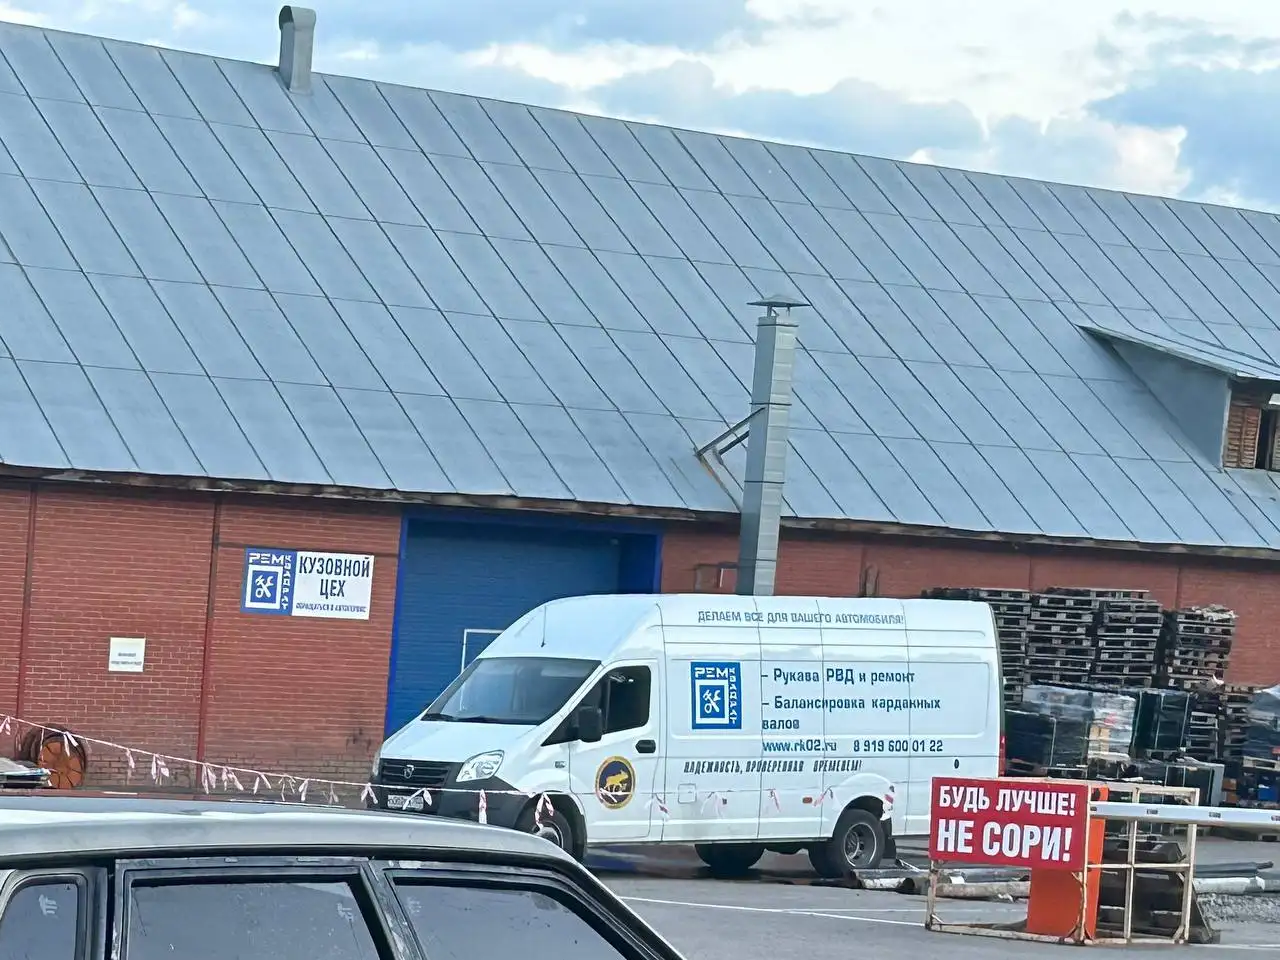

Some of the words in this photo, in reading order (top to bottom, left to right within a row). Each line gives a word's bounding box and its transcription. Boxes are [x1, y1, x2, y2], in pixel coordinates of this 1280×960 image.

[249, 553, 285, 564] РЕМ
[298, 556, 370, 577] КУЗОВНОЙ
[319, 579, 346, 599] ЦЕХ
[698, 611, 741, 623] ДЕЛАЕМ
[745, 612, 763, 622] ВСЕ
[767, 612, 788, 624] ДЛЯ
[791, 612, 831, 623] ВАШЕГО
[695, 667, 729, 678] РЕМ
[773, 668, 820, 685] Рукава
[826, 668, 854, 684] РВД
[859, 673, 866, 682] и
[871, 672, 915, 685] ремонт
[774, 695, 865, 712] Балансировка
[872, 698, 941, 712] карданных
[762, 719, 800, 730] валов
[762, 739, 837, 752] www.rk02.ru
[853, 740, 860, 752] 8
[863, 740, 884, 752] 919
[888, 740, 909, 752] 600
[912, 740, 926, 752] 01
[929, 740, 943, 752] 22
[939, 786, 990, 813] БУДЬ
[995, 788, 1076, 816] ЛУЧШЕ!
[937, 818, 974, 853] НЕ
[982, 821, 1073, 862] СОРИ!
